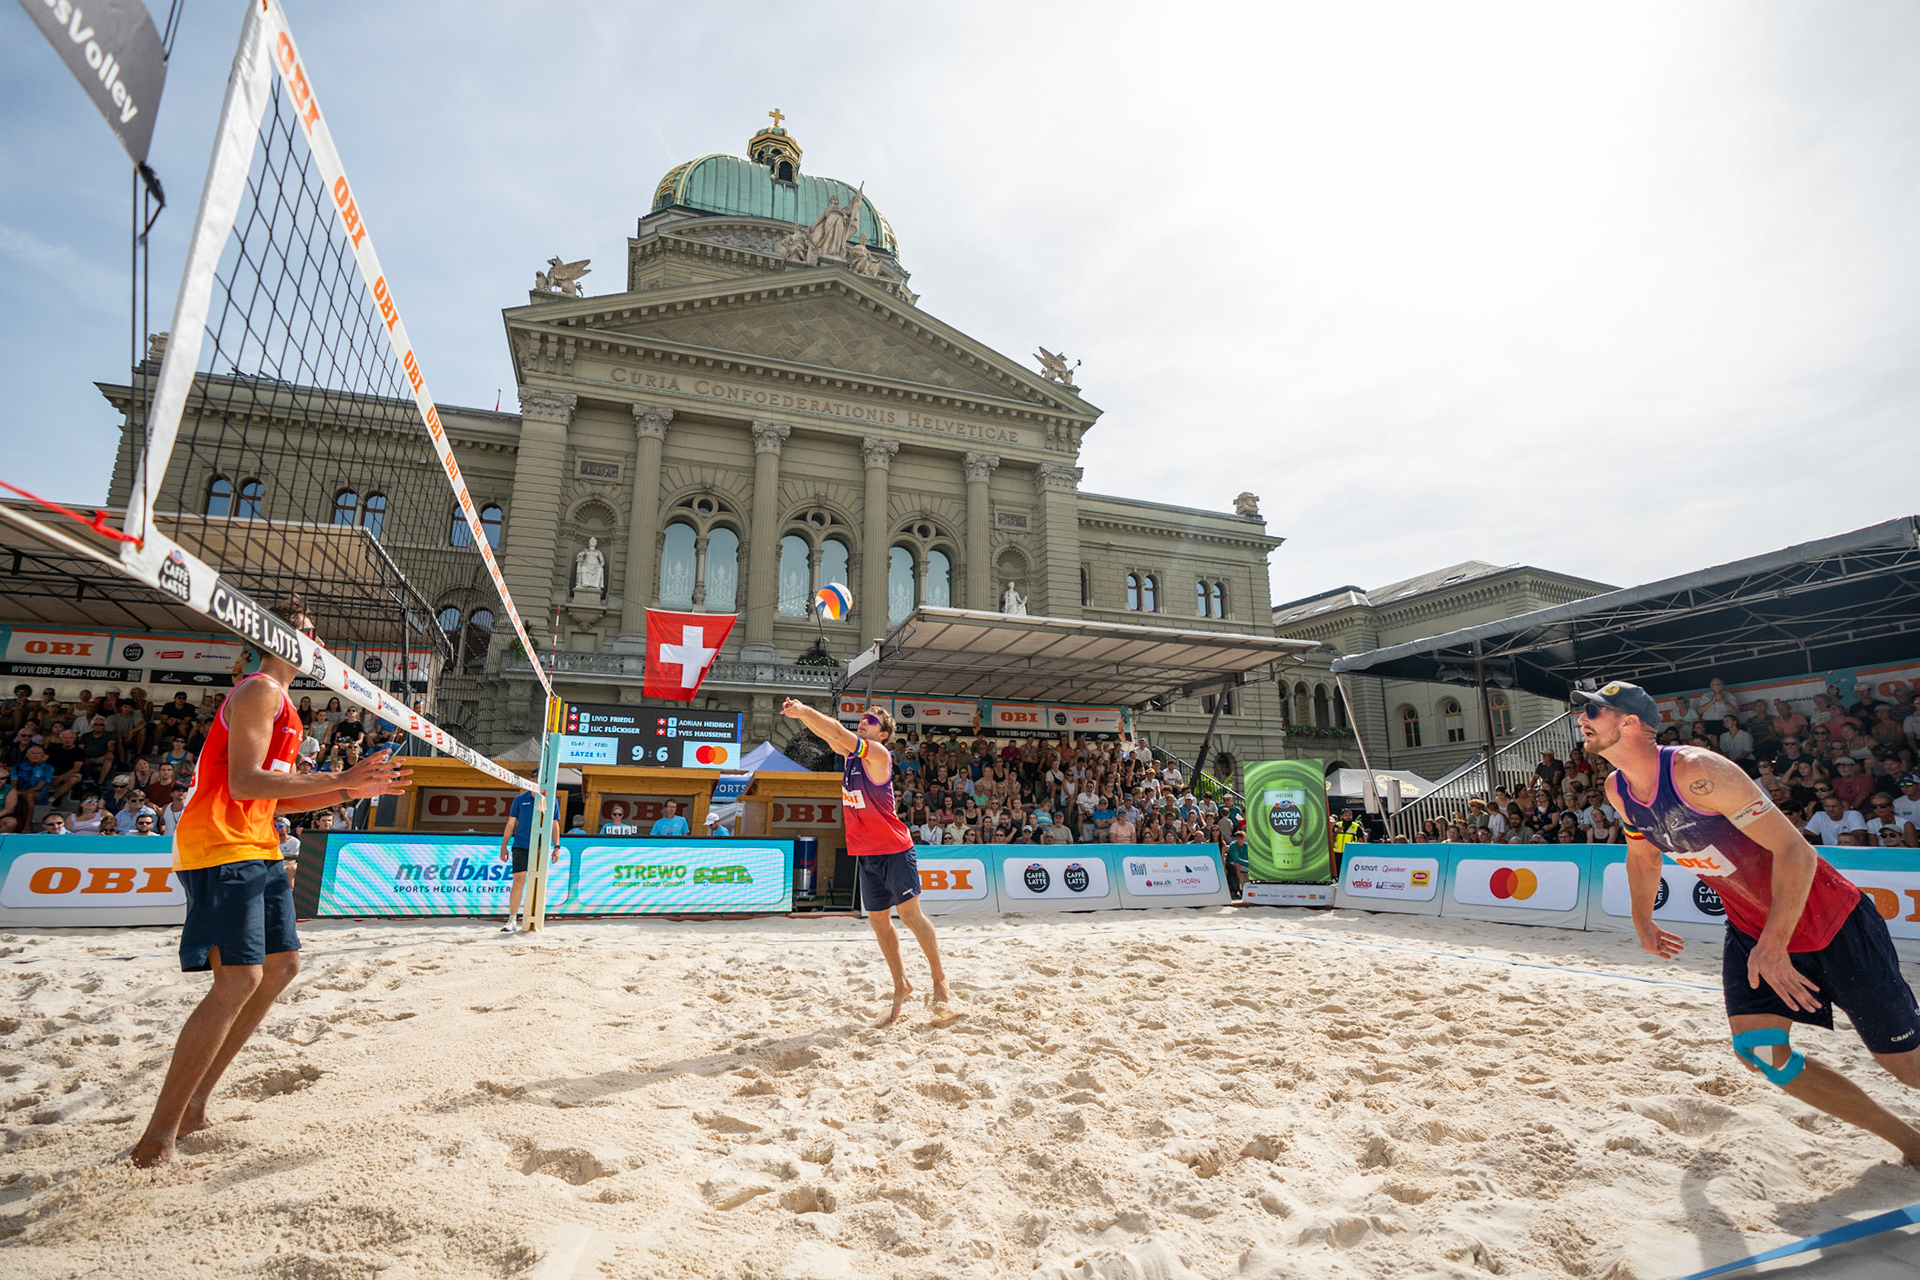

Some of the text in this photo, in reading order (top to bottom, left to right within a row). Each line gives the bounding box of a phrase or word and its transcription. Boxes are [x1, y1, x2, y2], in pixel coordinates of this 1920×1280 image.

[43, 0, 138, 123] sVolley
[276, 31, 320, 136] OBI
[333, 176, 366, 250] OBI
[373, 275, 399, 332] OBI
[403, 349, 424, 395] OBI
[610, 367, 1019, 443] CURIA CONFOEDERATIONIS HELVETICAE
[426, 406, 443, 443] OBI
[445, 452, 459, 482] OBI
[460, 488, 472, 512] OBI
[472, 518, 483, 540] OBI
[213, 588, 299, 664] CAFFÈ LATTE
[24, 640, 94, 656] OBI
[11, 665, 121, 680] WWW.OBI-BEACH-TOUR.CH
[591, 715, 609, 723] LIVIO
[610, 715, 635, 724] FRIEDLI
[678, 720, 702, 728] ADRIAN
[703, 721, 734, 729] HEIDRICH
[1001, 712, 1038, 723] OBI
[694, 731, 732, 739] HAUSSENER
[570, 750, 594, 758] SÄTZE
[631, 745, 644, 761] 9
[656, 746, 669, 762] 6
[716, 784, 747, 793] ORTS
[1271, 811, 1301, 819] MATCHA
[614, 865, 687, 880] STREWO
[1026, 870, 1046, 879] CAFFÈ
[1361, 864, 1406, 873] smart Quooker
[29, 867, 174, 894] OBI
[919, 870, 974, 890] BI
[1176, 877, 1200, 885] THORN
[1352, 878, 1373, 888] valais
[393, 885, 512, 893] SPORTS MEDICAL CENTER
[1699, 896, 1722, 904] LAT
